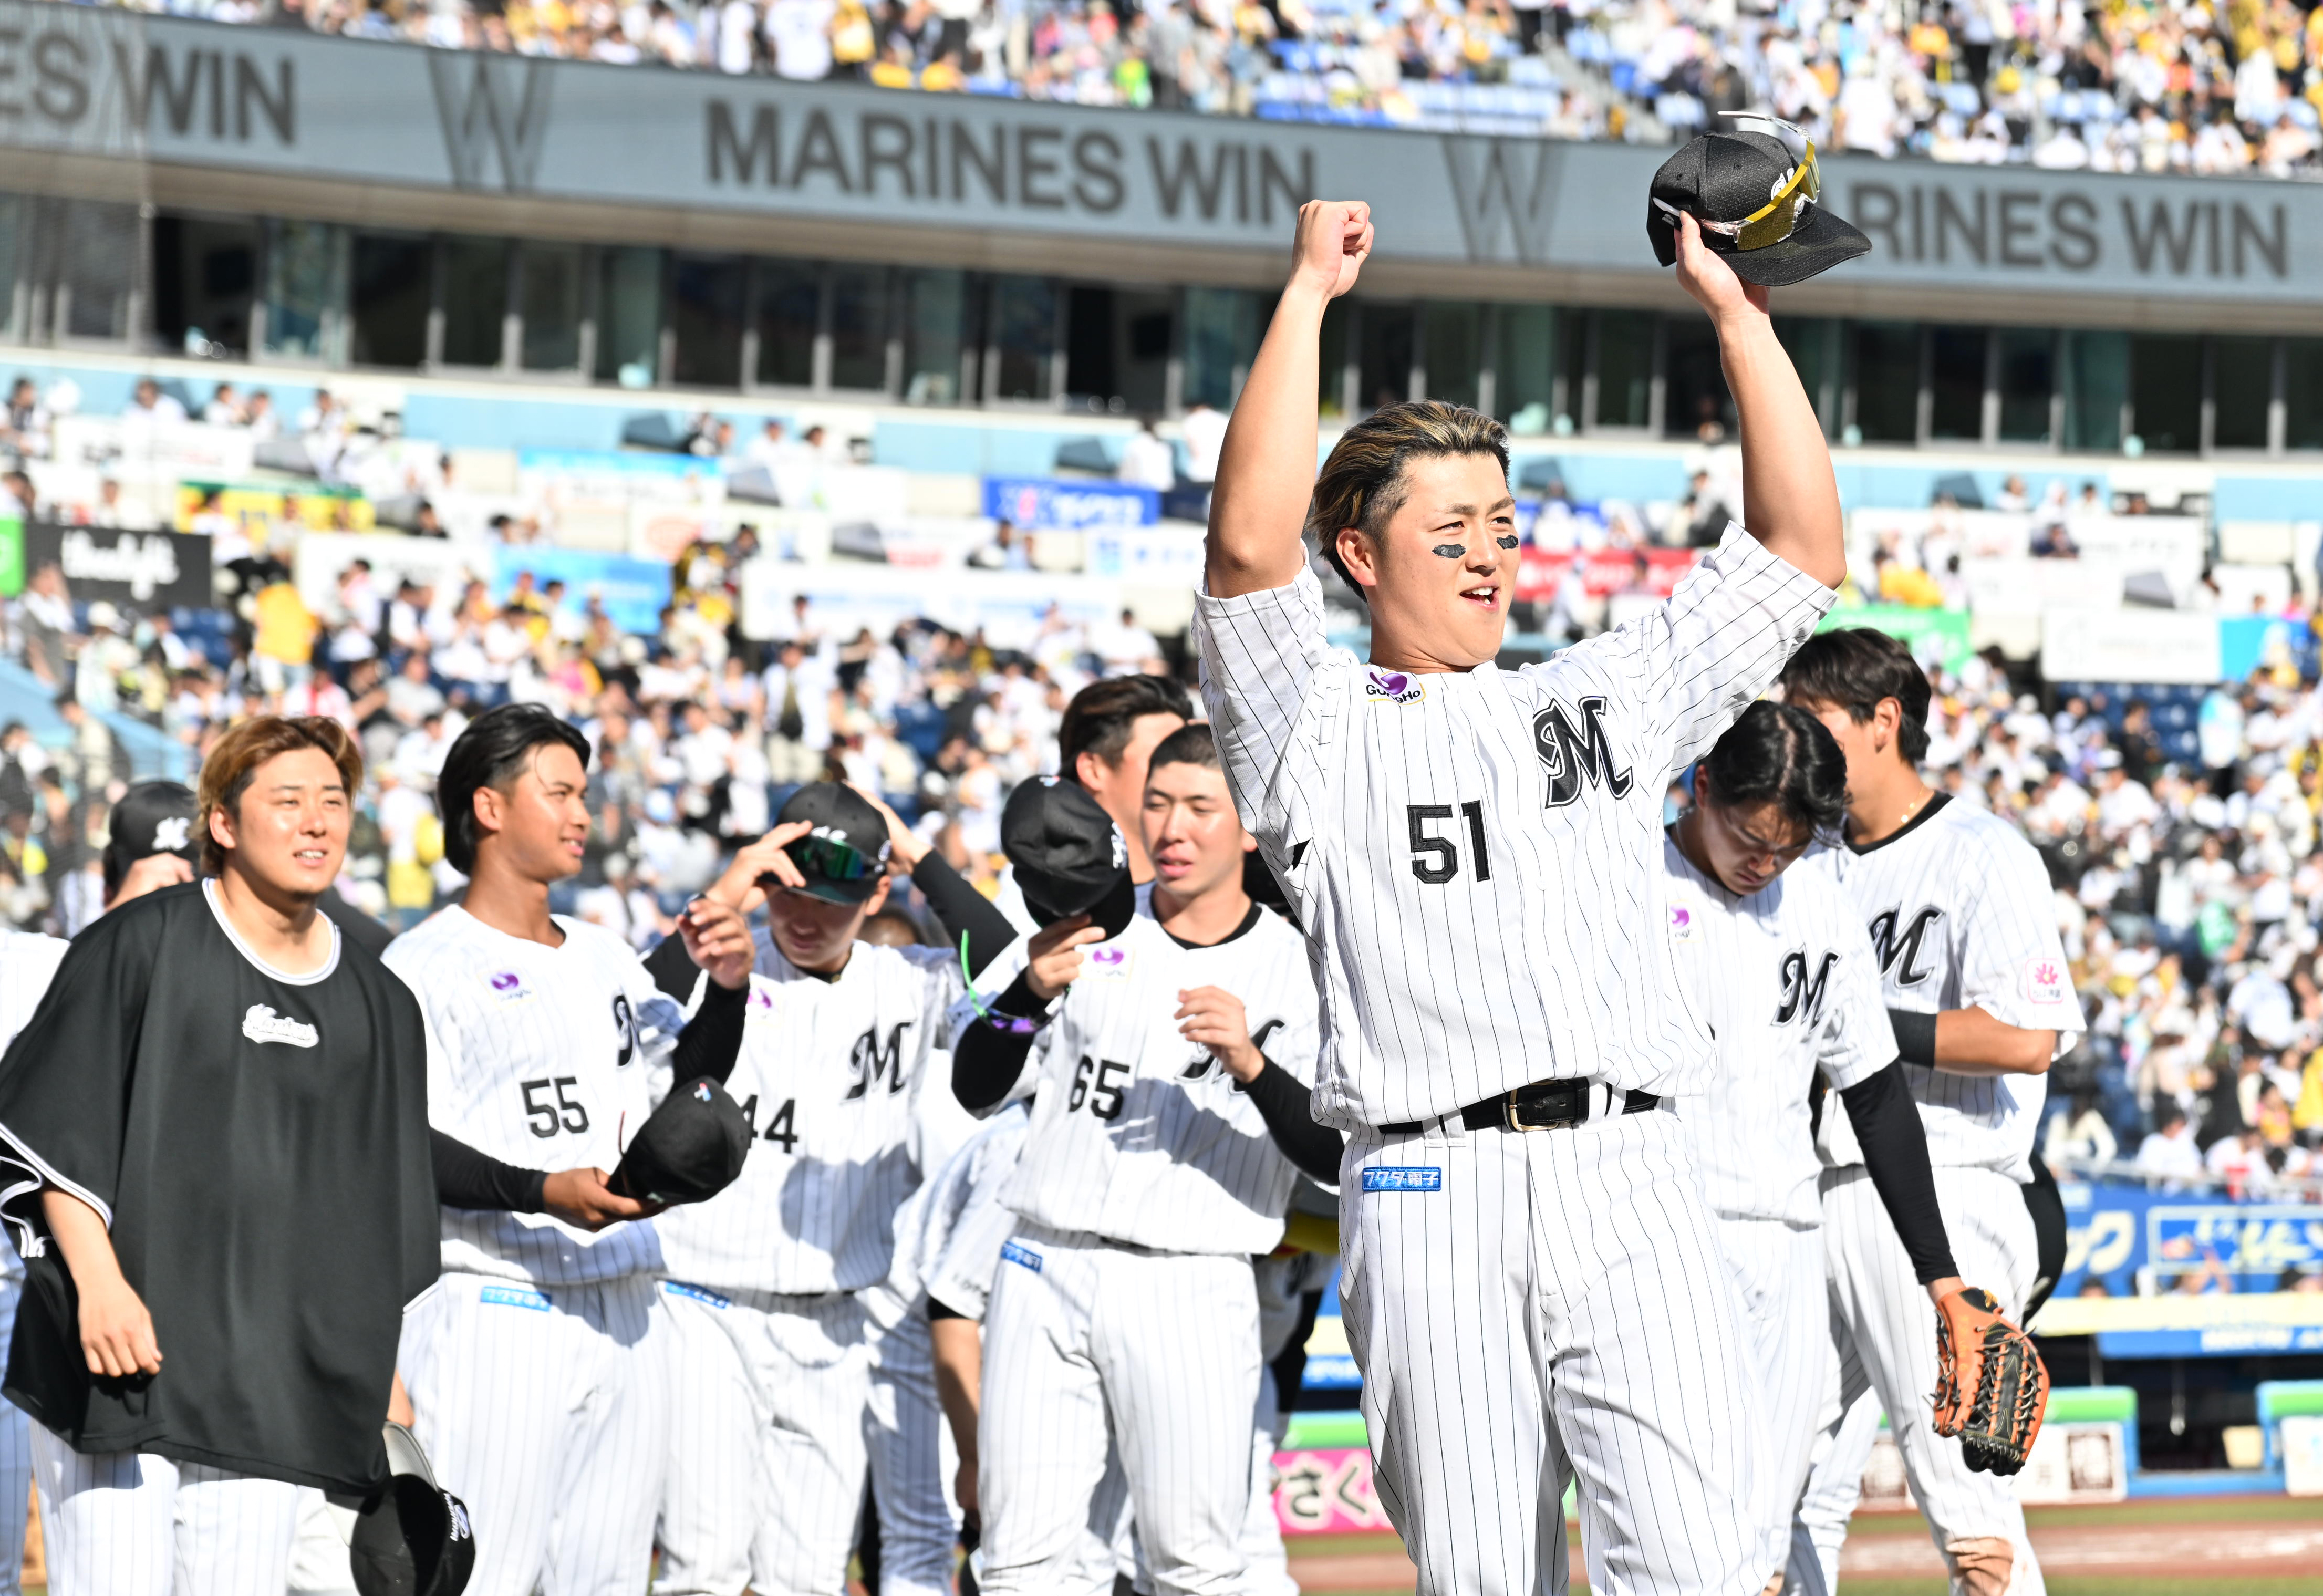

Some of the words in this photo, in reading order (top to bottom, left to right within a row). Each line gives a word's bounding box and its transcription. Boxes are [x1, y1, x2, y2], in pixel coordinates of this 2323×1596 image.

[112, 42, 295, 144] WIN
[707, 99, 1126, 213] MARINES
[1146, 135, 1314, 225] WIN
[1821, 181, 2100, 271] RINES
[2121, 199, 2287, 277] WIN
[1533, 697, 1633, 809] M
[1407, 800, 1490, 884] 51
[1771, 945, 1843, 1032] M
[843, 1020, 916, 1103] M
[1070, 1055, 1129, 1120] 65
[521, 1077, 589, 1138] 55
[1364, 1171, 1439, 1186] フクダ電子
